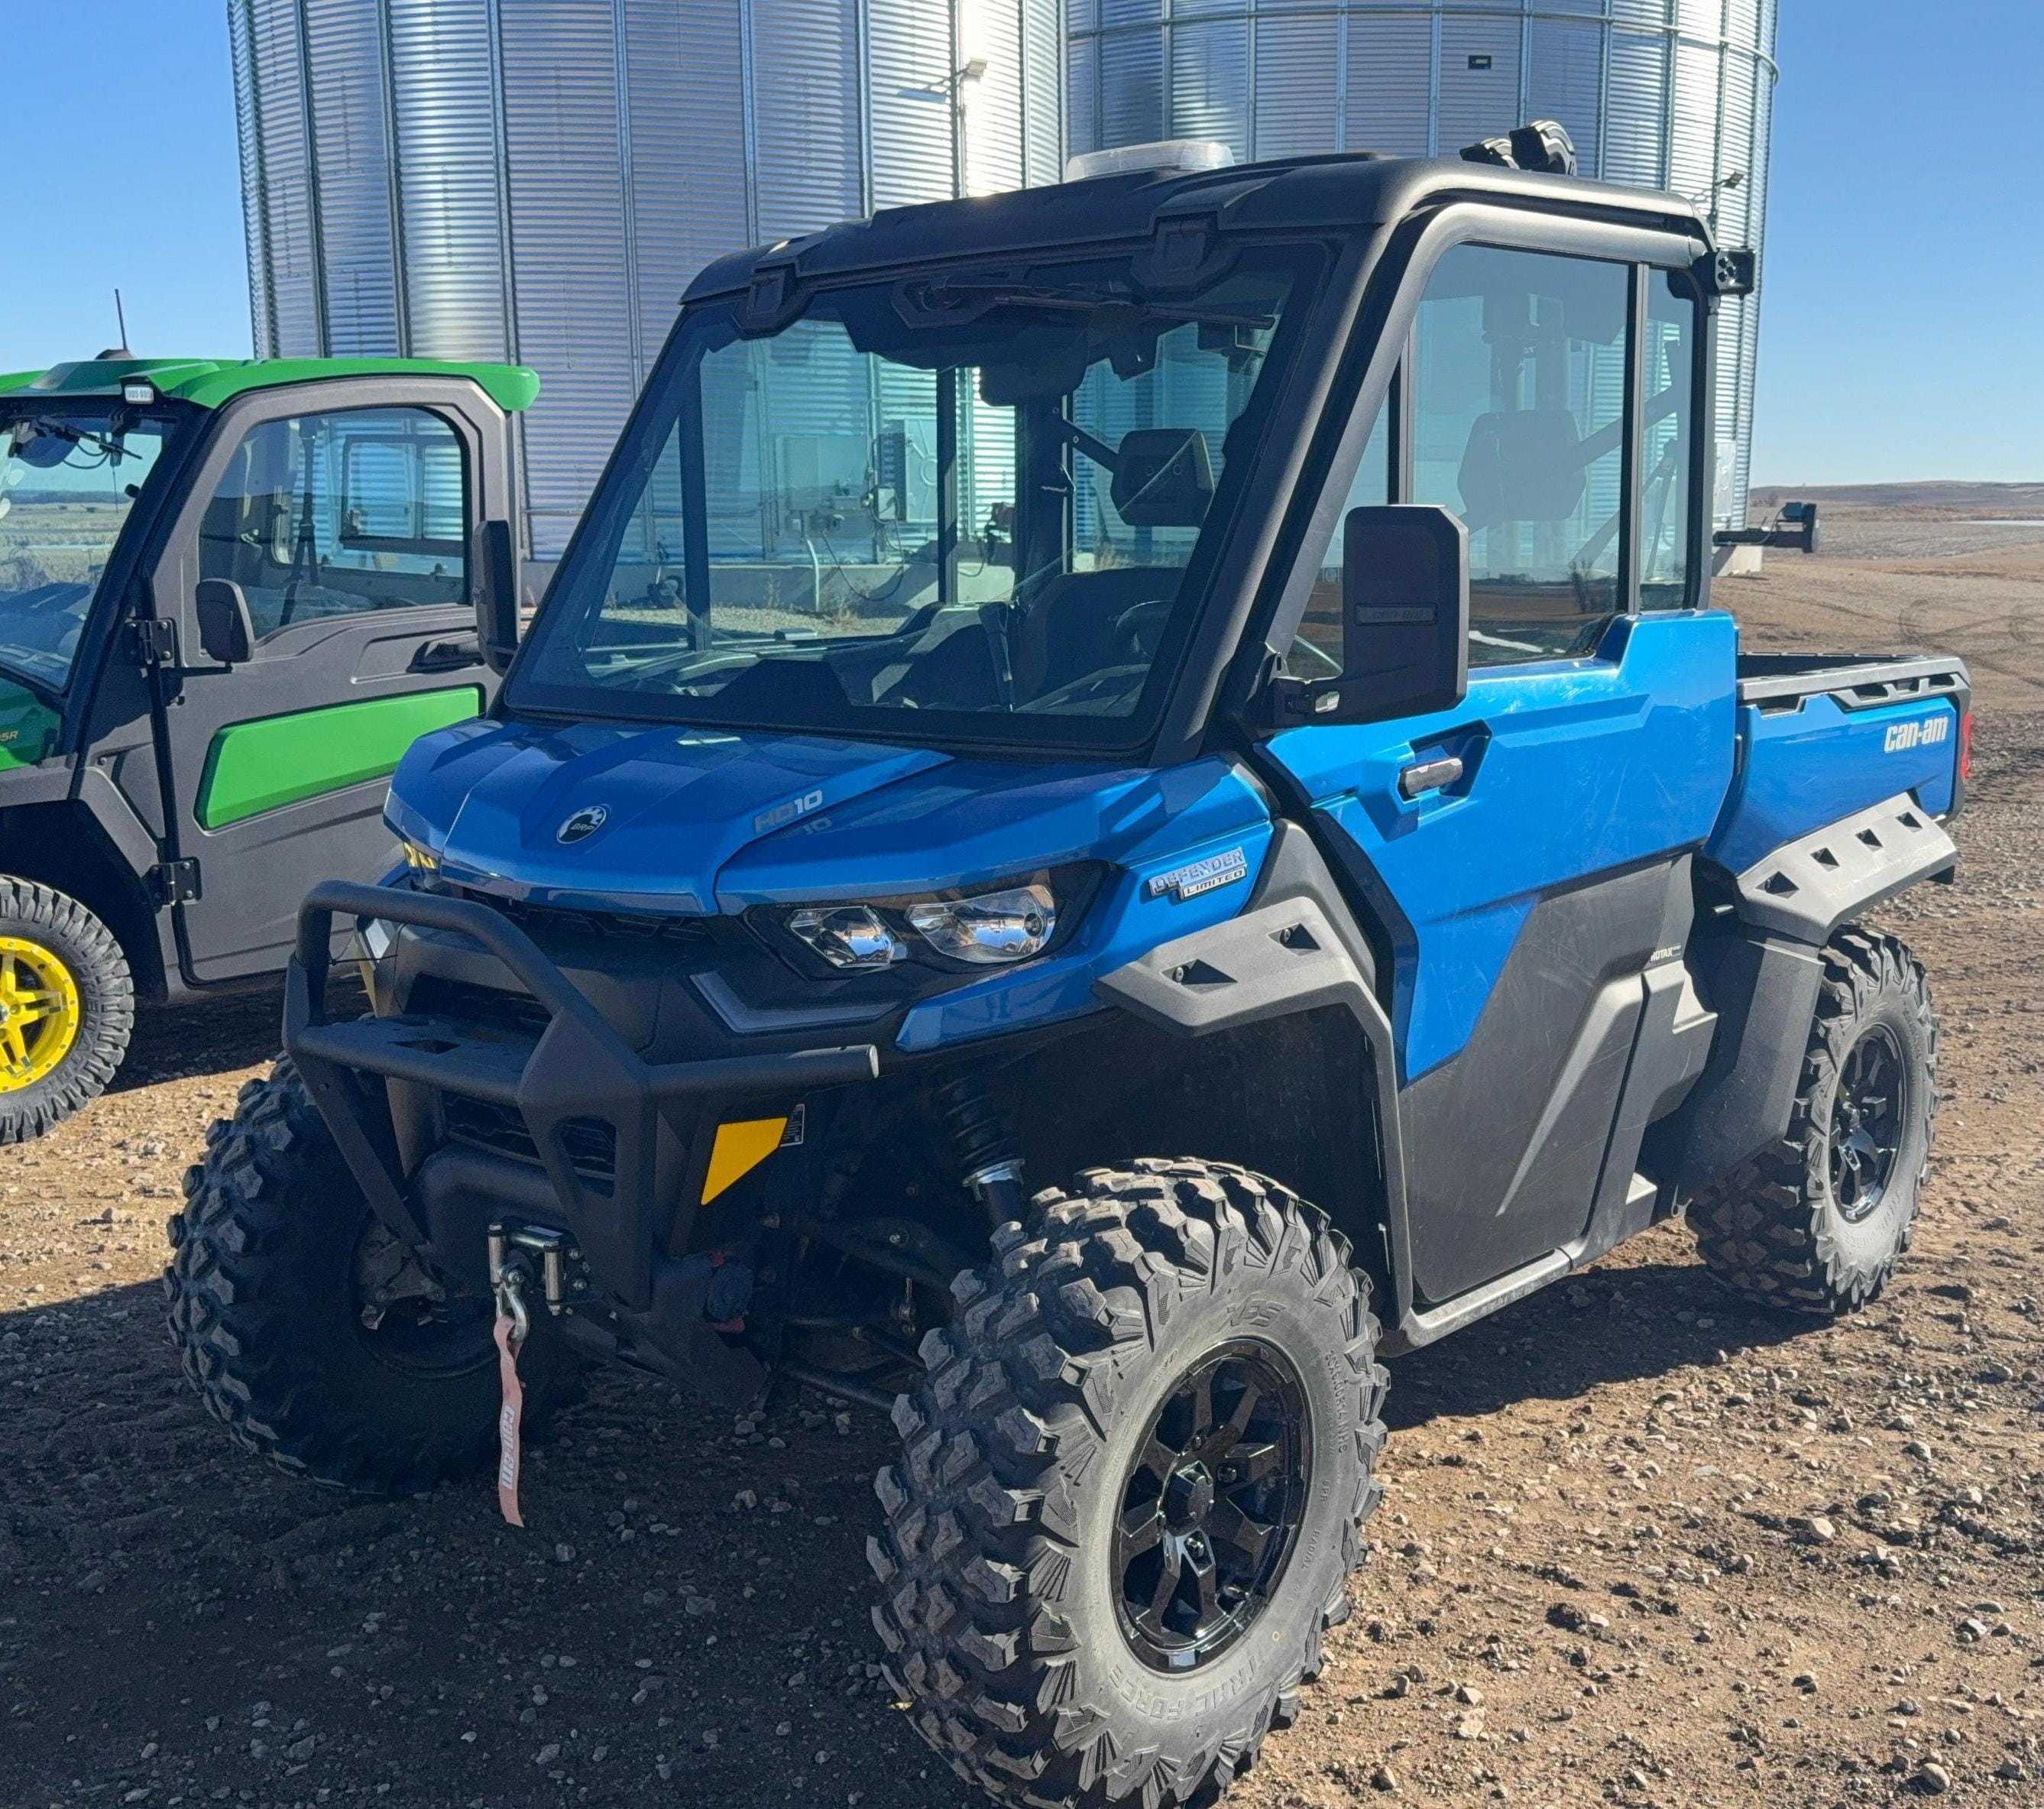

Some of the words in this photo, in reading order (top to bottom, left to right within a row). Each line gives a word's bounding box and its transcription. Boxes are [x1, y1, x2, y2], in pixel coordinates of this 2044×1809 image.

[0, 731, 18, 741] 5R
[1884, 716, 1948, 754] can-am
[1154, 849, 1243, 890] DEFENDER
[1187, 870, 1242, 894] LIMITED
[501, 1404, 515, 1490] can-am
[1301, 1530, 1320, 1569] RADIAL
[1109, 1665, 1184, 1720] FORCE
